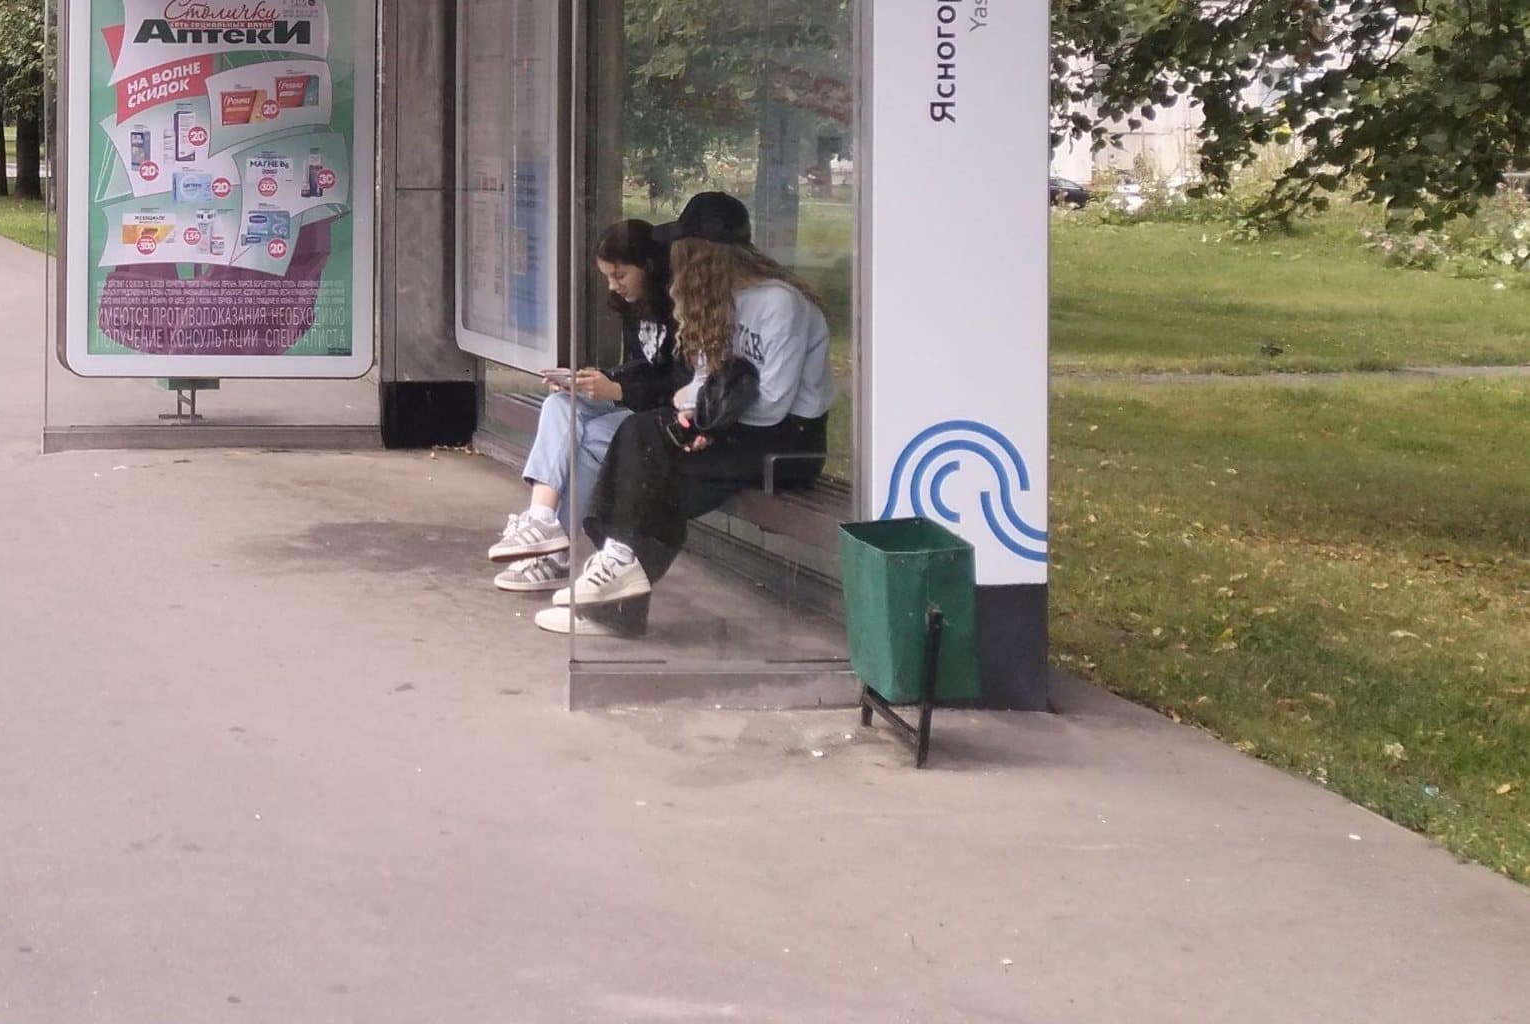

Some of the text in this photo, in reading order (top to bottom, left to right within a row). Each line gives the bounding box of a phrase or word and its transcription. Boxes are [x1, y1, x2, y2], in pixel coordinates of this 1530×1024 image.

[127, 62, 201, 94] НА ВОЛНЕ
[127, 79, 190, 108] СКИДОК
[98, 306, 149, 326] ИМЕЮТСЯ
[271, 306, 346, 326] НЕОБХОДИМО
[97, 328, 346, 349] ПОЛУЧЕНИЕ КОНСУЛЬТАЦИИ СПЕЦИАЛИСТА
